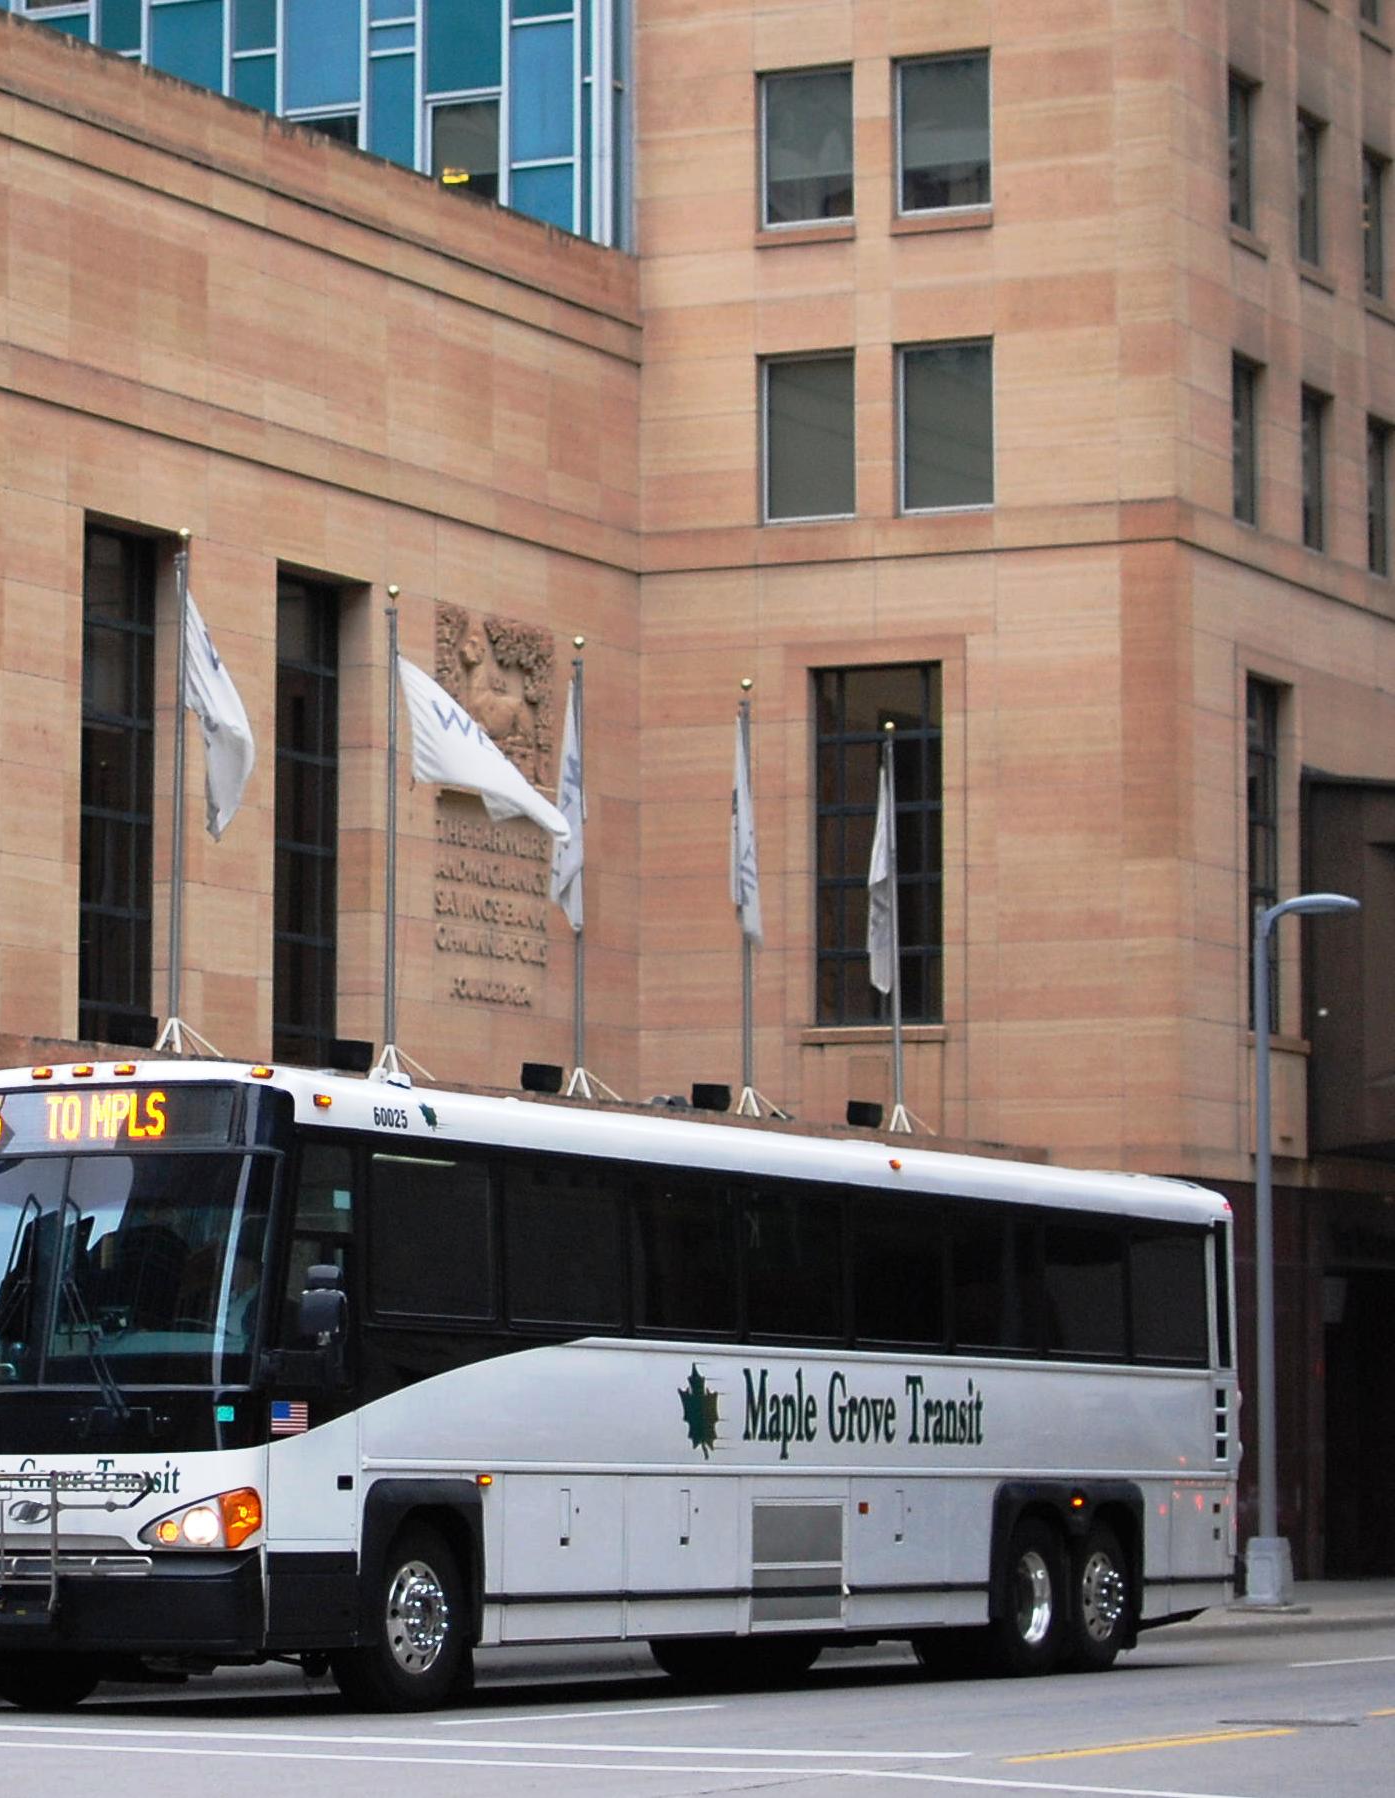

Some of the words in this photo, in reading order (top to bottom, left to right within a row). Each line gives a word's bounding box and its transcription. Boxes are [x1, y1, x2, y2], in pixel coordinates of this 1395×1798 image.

[44, 1094, 82, 1141] TO
[89, 1091, 167, 1139] MPLS
[373, 1106, 408, 1129] 60025
[742, 1366, 818, 1460] Maple
[828, 1370, 897, 1444] Grove
[905, 1374, 984, 1446] Transit
